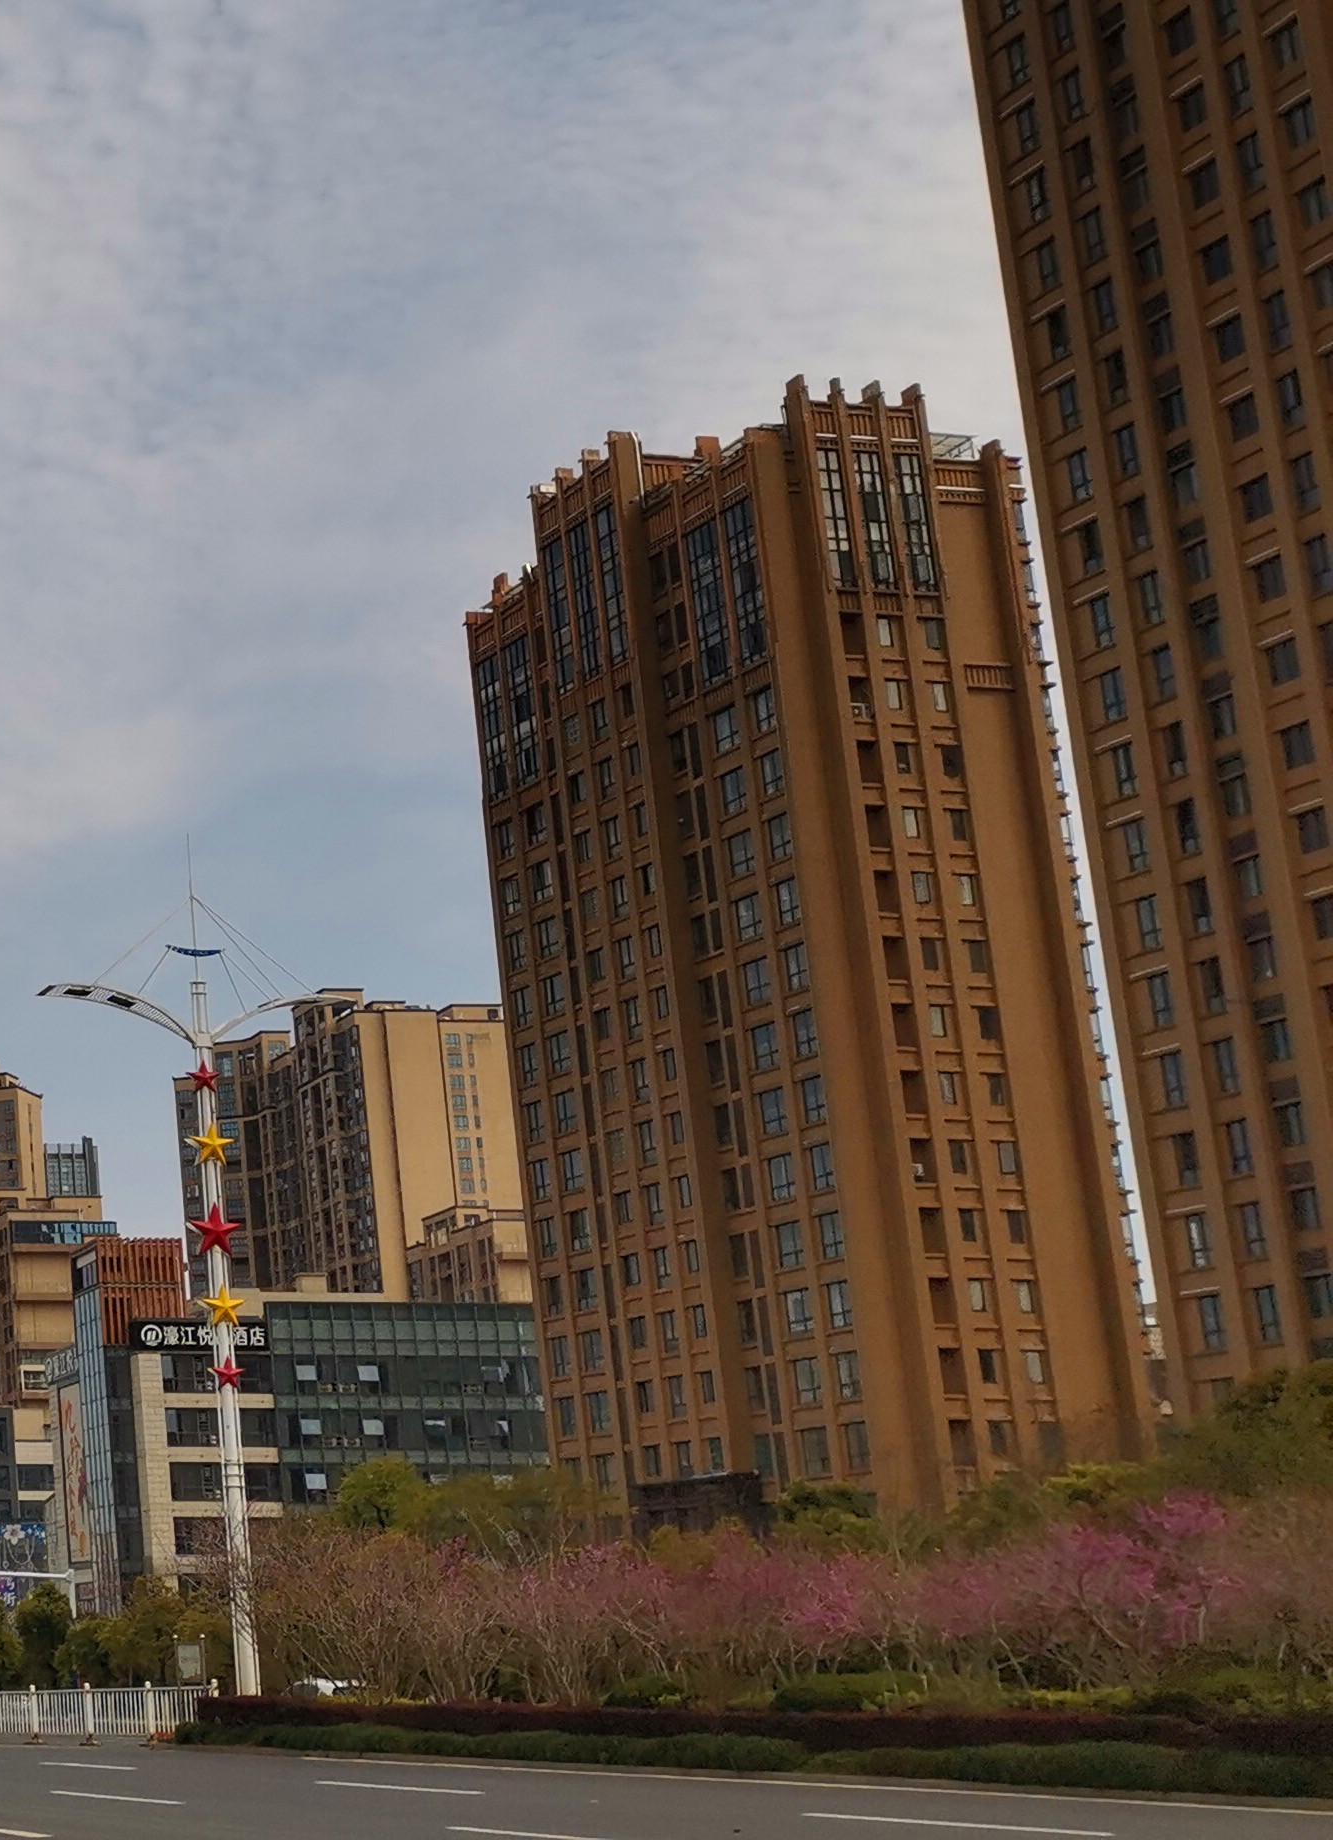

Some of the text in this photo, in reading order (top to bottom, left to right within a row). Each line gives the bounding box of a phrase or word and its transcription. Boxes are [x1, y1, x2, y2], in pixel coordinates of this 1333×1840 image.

[163, 1325, 266, 1346] 濠江悦酒店
